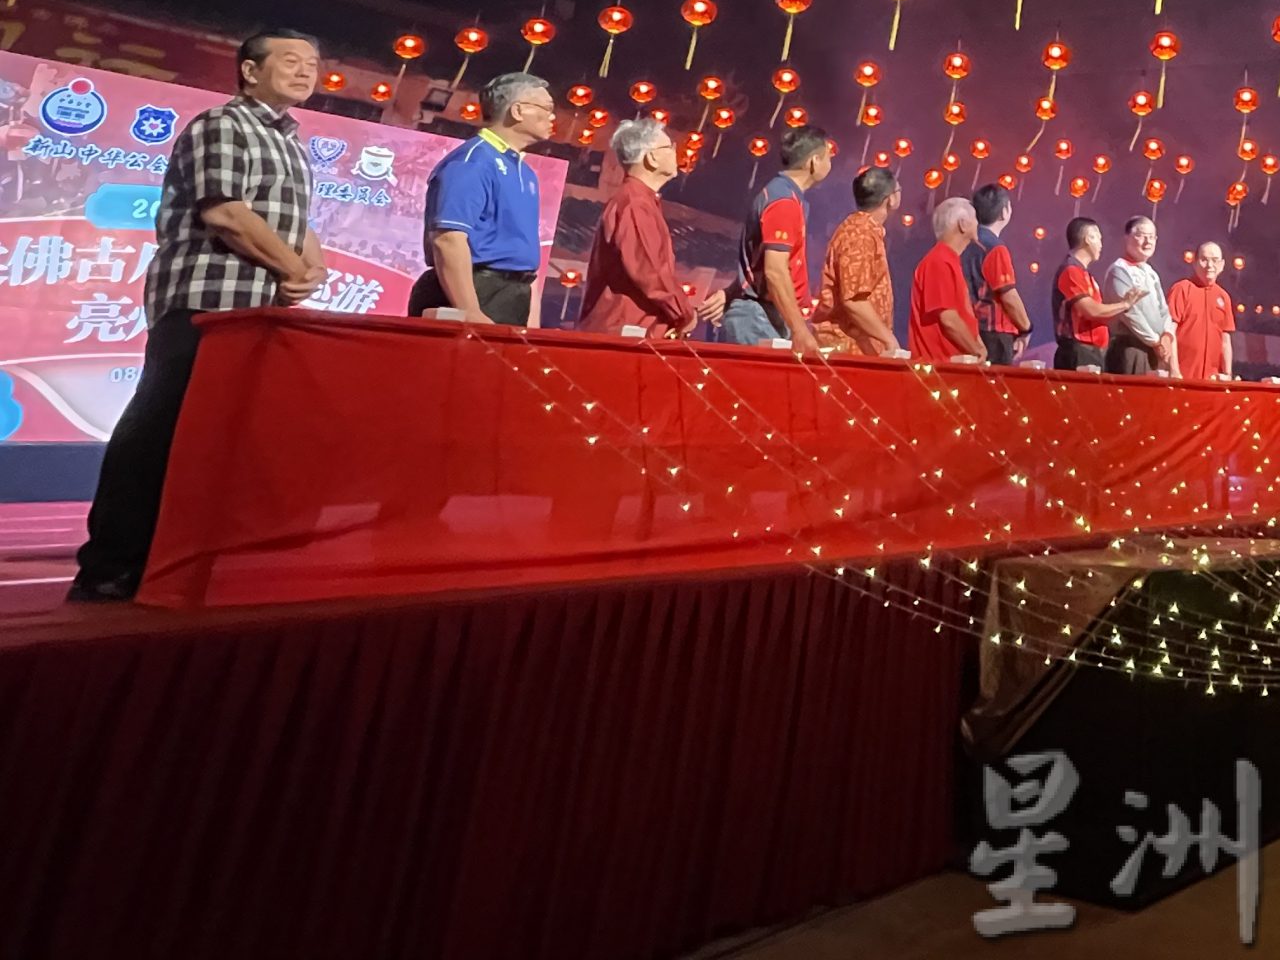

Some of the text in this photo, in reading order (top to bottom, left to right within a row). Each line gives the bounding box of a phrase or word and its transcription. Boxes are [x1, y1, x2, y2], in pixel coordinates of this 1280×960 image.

[313, 181, 391, 206] 理委员会
[0, 236, 160, 286] 佛古
